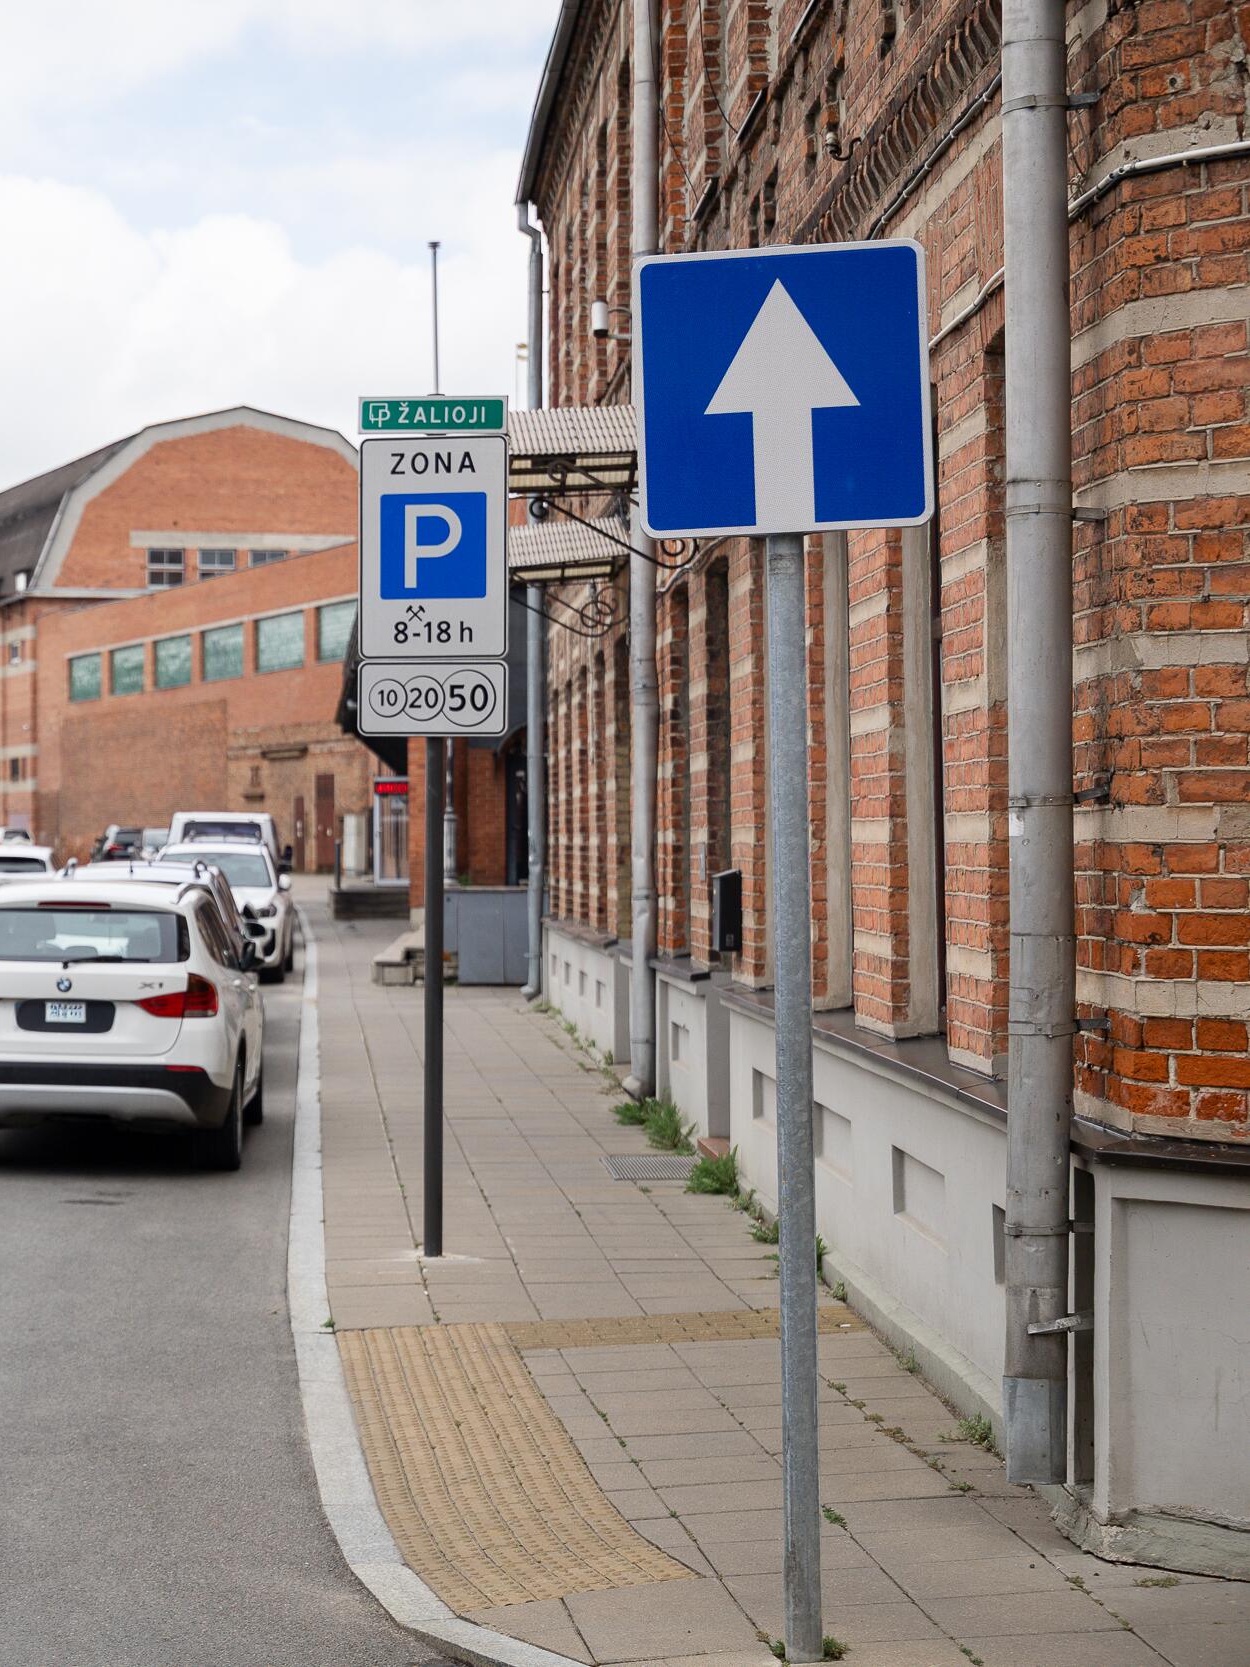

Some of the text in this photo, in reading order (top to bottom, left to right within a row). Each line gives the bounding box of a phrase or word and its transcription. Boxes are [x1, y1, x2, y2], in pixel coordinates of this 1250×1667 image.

[397, 402, 486, 424] ŽALIOJI
[390, 451, 476, 475] ZONA
[404, 503, 463, 589] P
[393, 621, 473, 644] 8-18 h
[377, 683, 489, 712] 10 20 50
